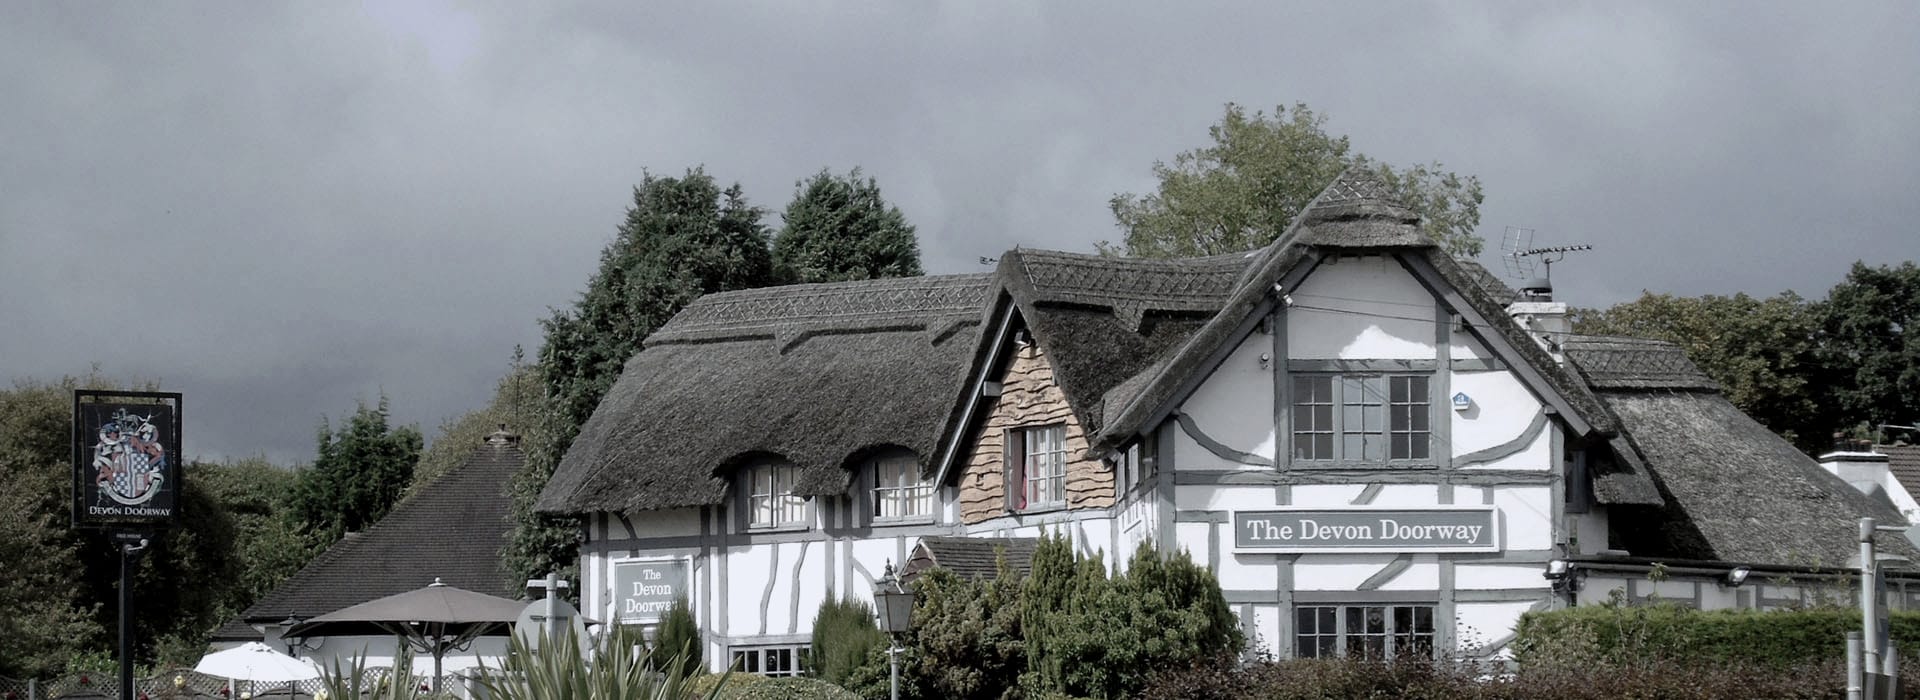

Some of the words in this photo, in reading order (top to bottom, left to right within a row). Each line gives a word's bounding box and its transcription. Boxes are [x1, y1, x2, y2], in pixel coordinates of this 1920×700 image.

[89, 506, 121, 515] DEVON
[124, 506, 171, 516] DOORWAY
[1246, 519, 1293, 540] The
[1299, 519, 1372, 540] Devon
[1379, 519, 1483, 543] Doorway
[642, 569, 661, 580] The
[632, 581, 672, 596] Devon
